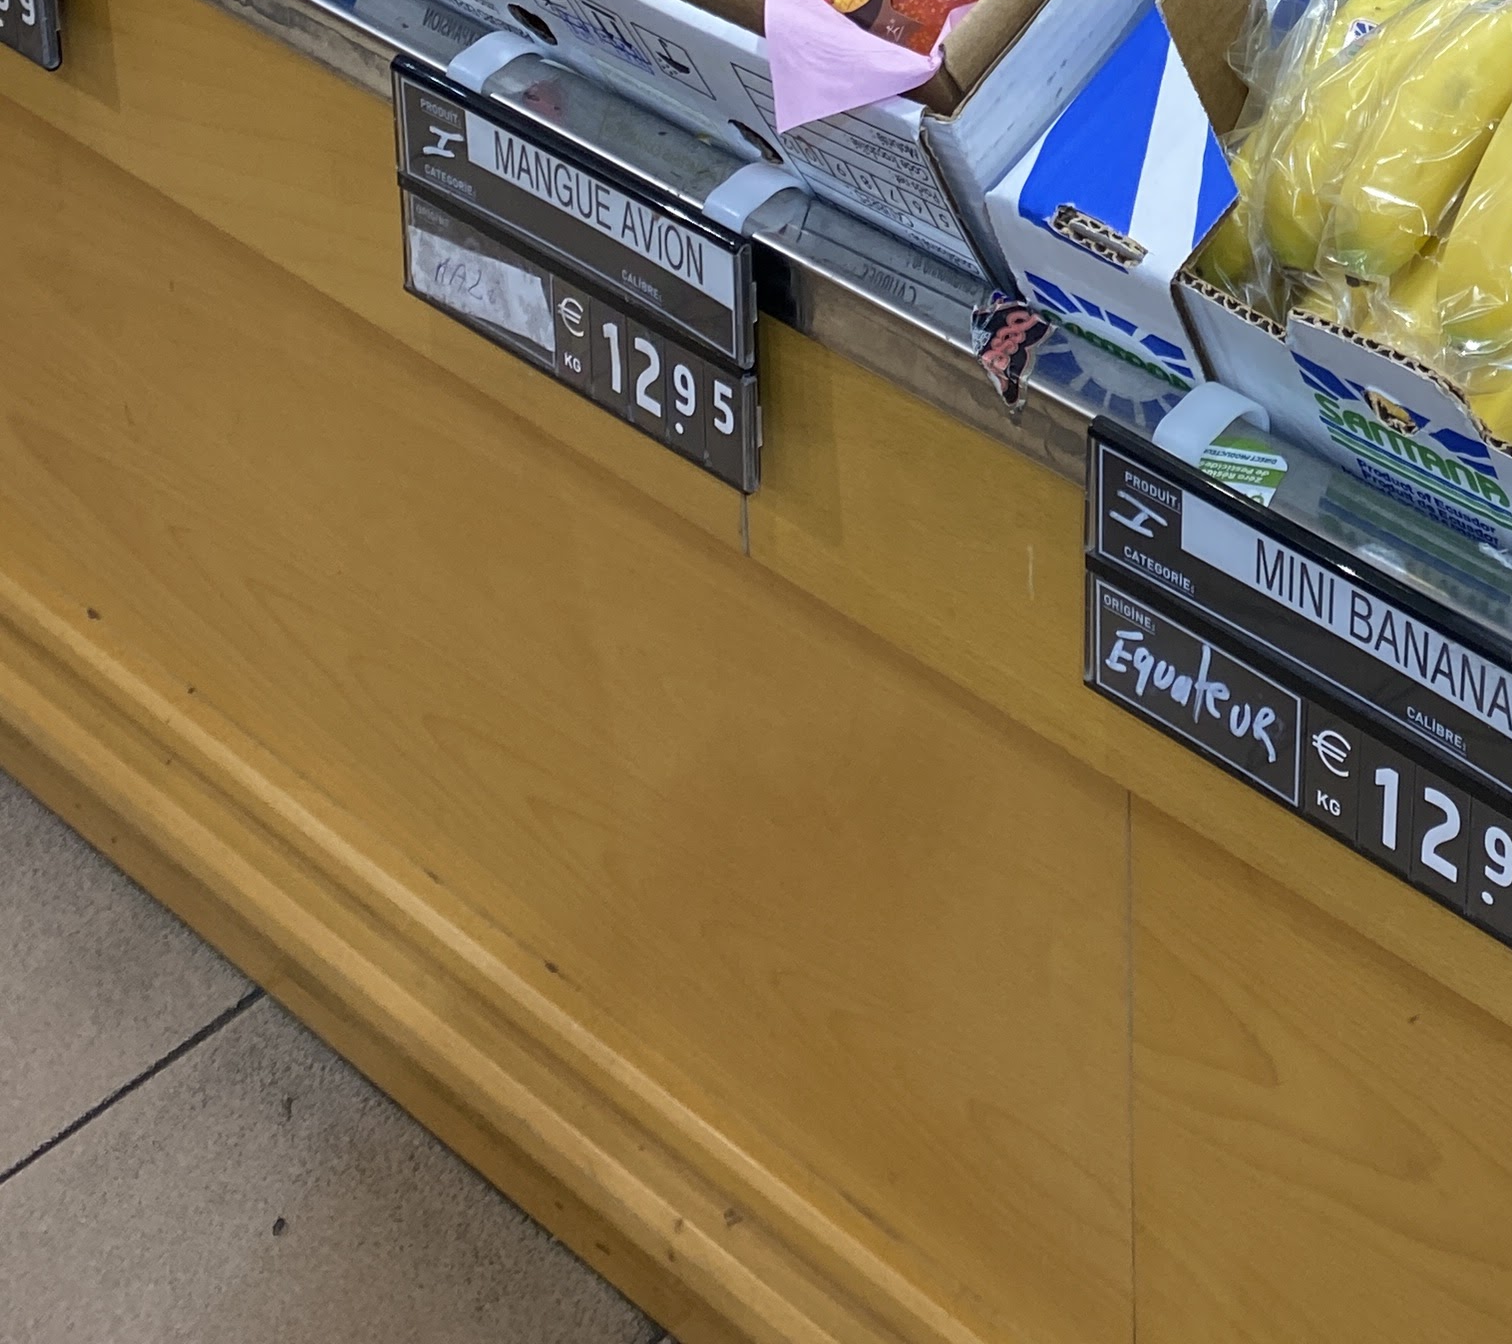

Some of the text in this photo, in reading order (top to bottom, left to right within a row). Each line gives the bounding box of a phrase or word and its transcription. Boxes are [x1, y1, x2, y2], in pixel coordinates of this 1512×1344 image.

[493, 131, 705, 286] MANGUE AVION
[564, 351, 582, 374] KG
[1313, 392, 1511, 508] SANTANA
[1356, 456, 1413, 495] Product
[1434, 496, 1496, 538] Ecuador
[1256, 538, 1336, 620] MINI
[1316, 789, 1341, 818] KG
